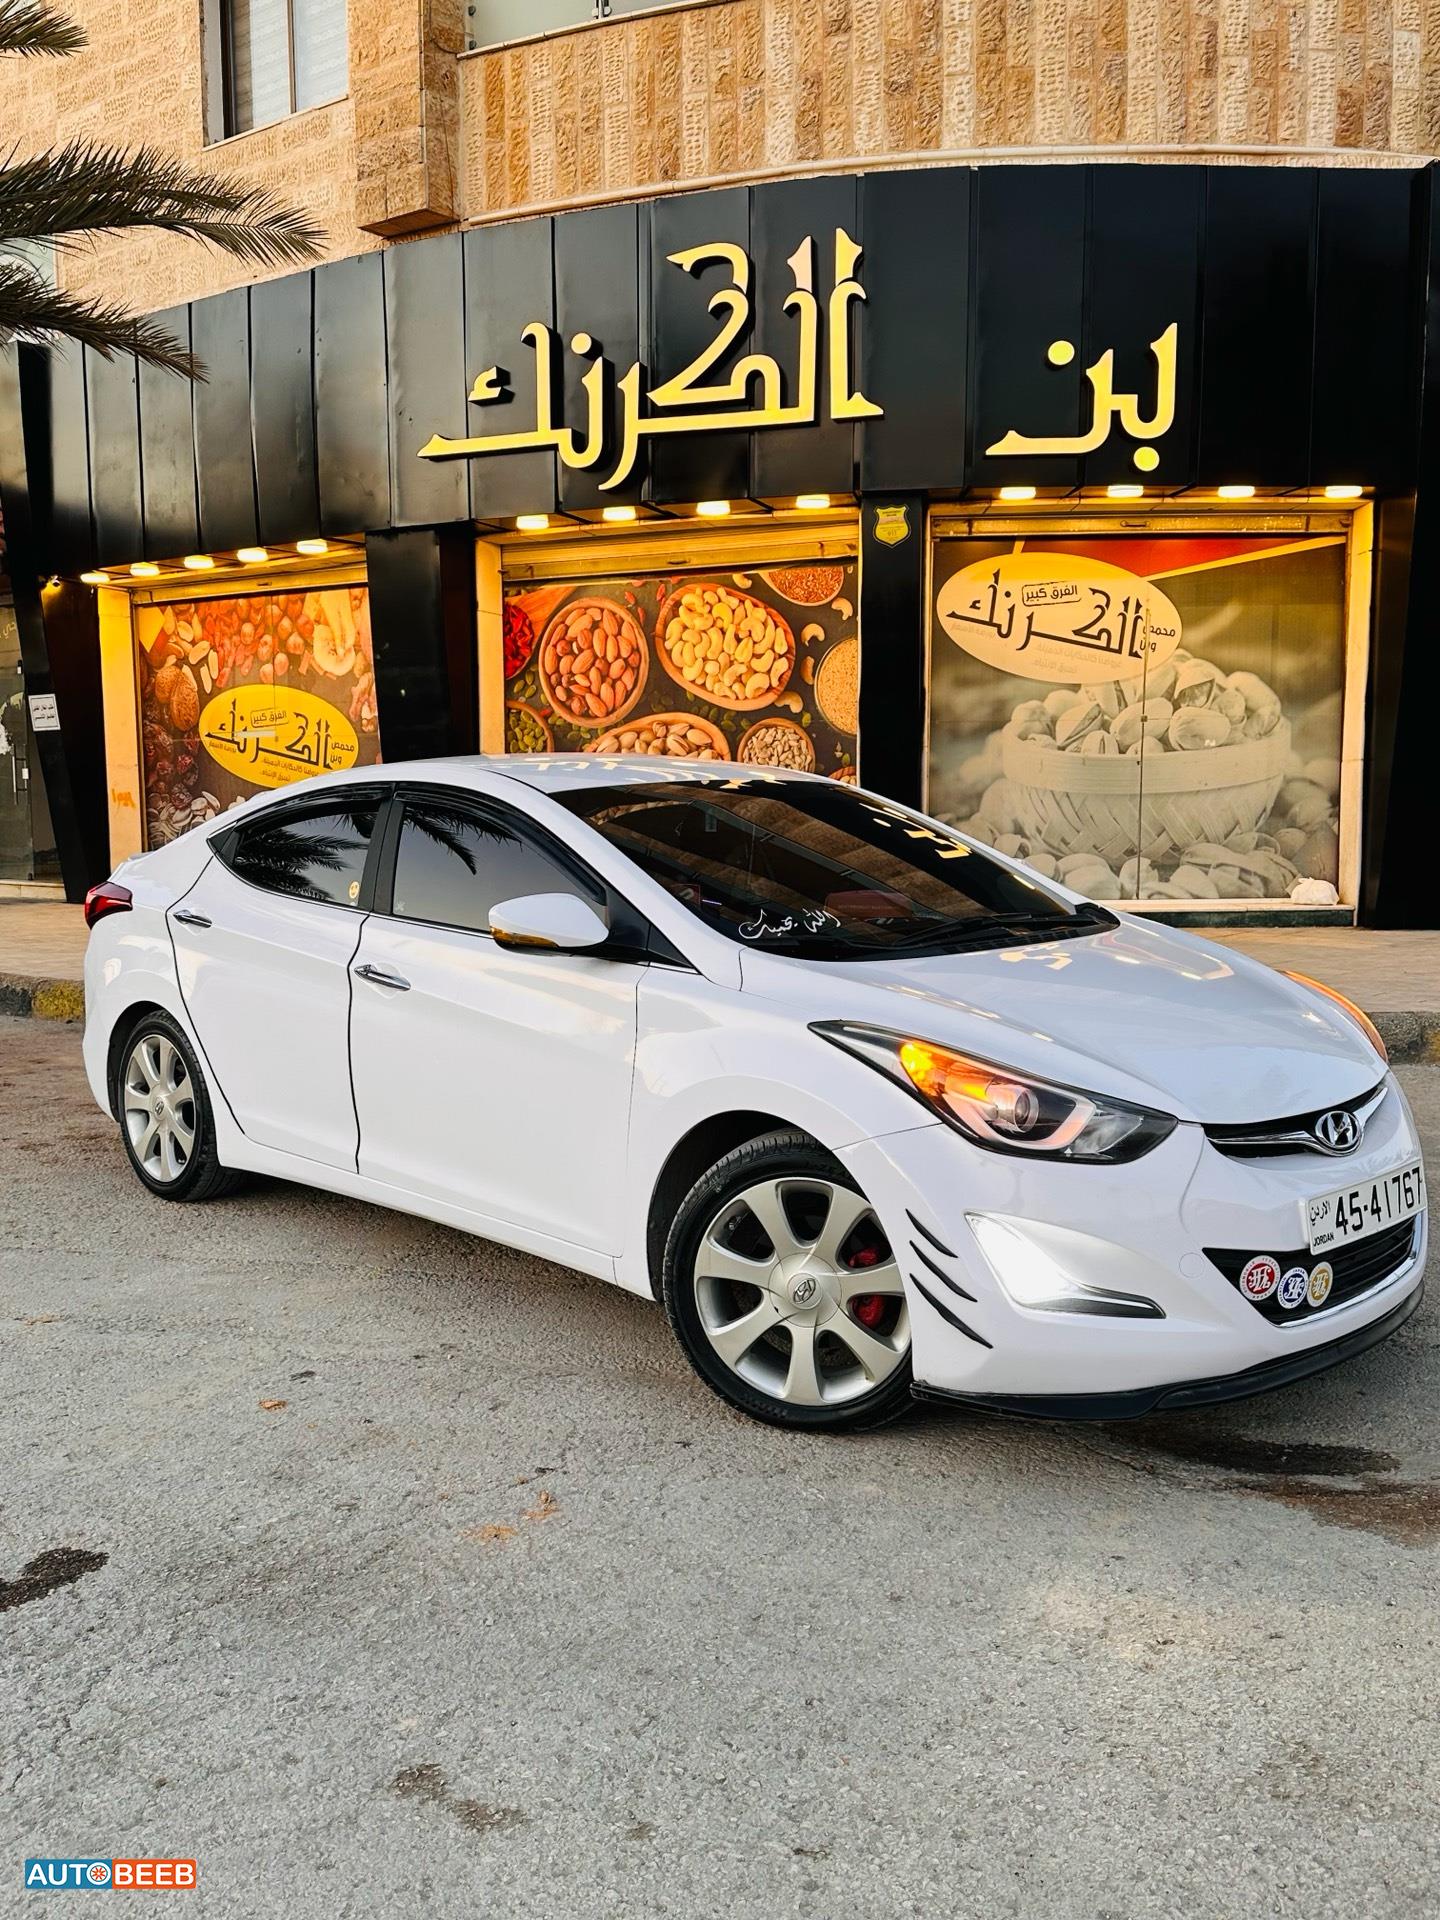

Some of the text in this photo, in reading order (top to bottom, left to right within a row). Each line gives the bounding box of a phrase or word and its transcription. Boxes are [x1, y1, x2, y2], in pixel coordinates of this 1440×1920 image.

[416, 227, 1180, 491] بن الكرنك
[945, 568, 1143, 659] الكرنك
[1026, 584, 1078, 602] الفرق كبير
[1313, 1232, 1335, 1247] JORDAN
